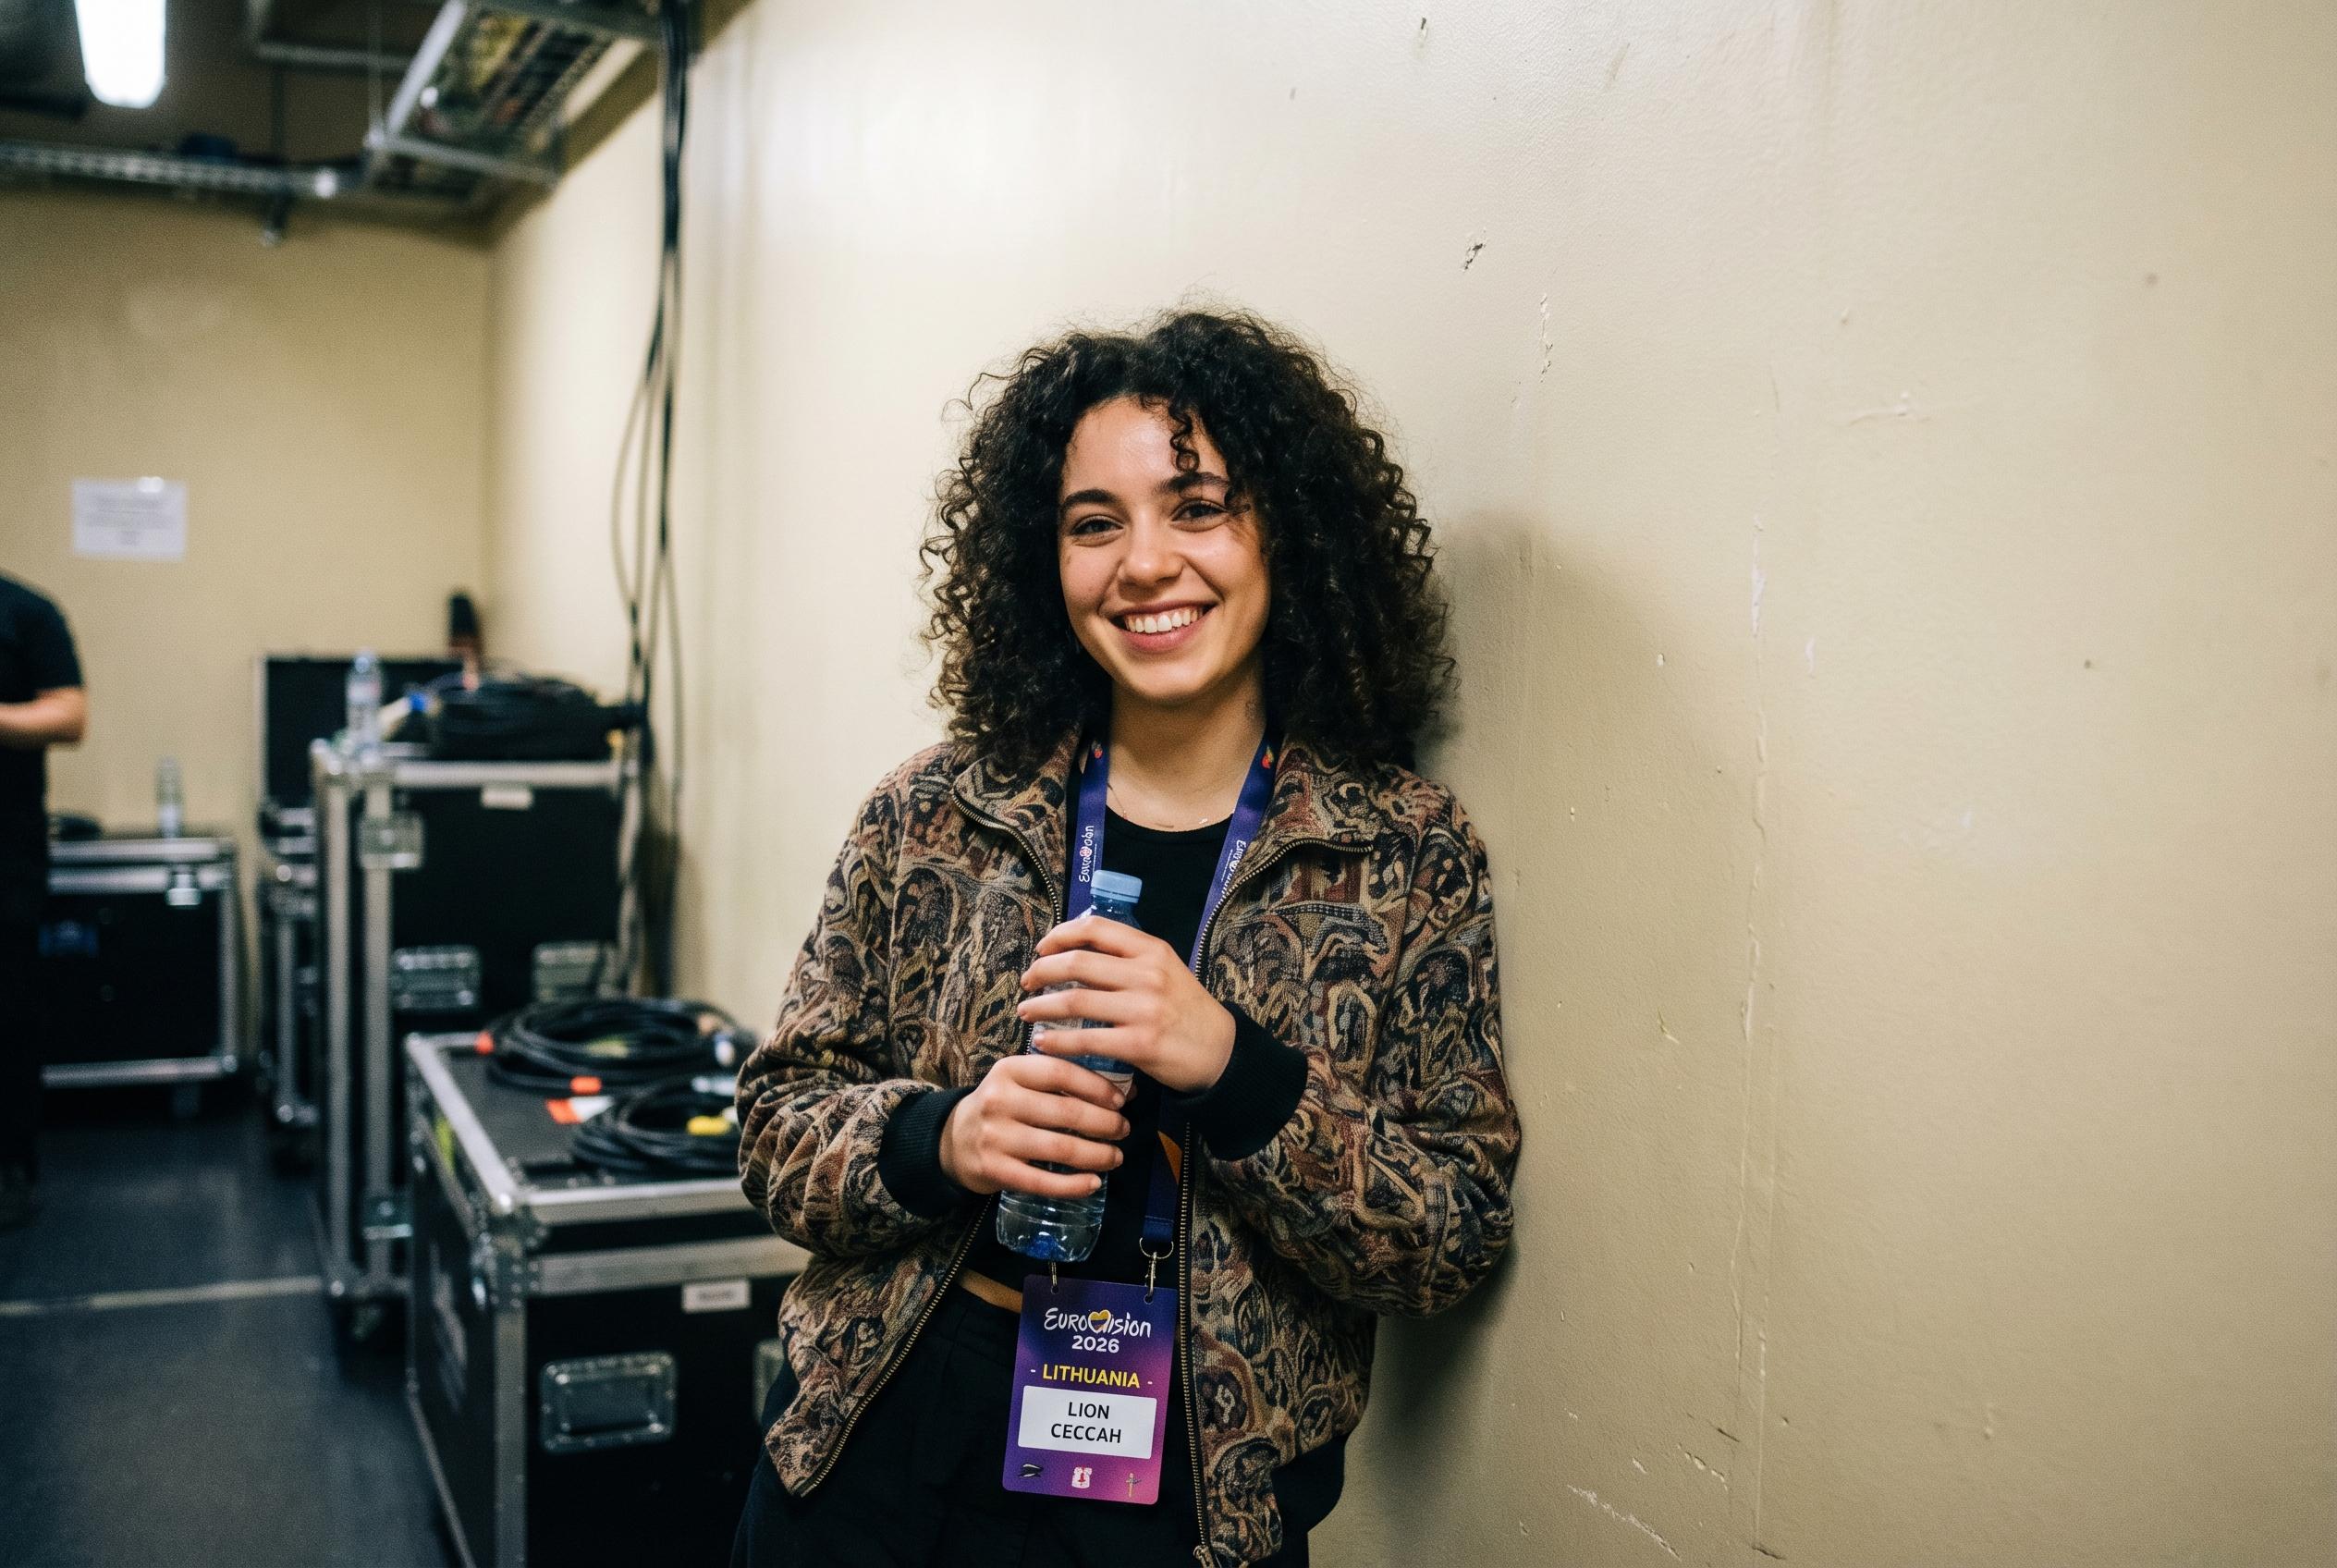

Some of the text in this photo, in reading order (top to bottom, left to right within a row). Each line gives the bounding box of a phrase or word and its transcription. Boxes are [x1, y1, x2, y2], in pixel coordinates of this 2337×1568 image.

[1071, 1334, 1120, 1354] 2026
[1043, 1364, 1141, 1389] LITHUANIA
[1068, 1402, 1110, 1420] LION
[1050, 1423, 1122, 1444] CECCAH
